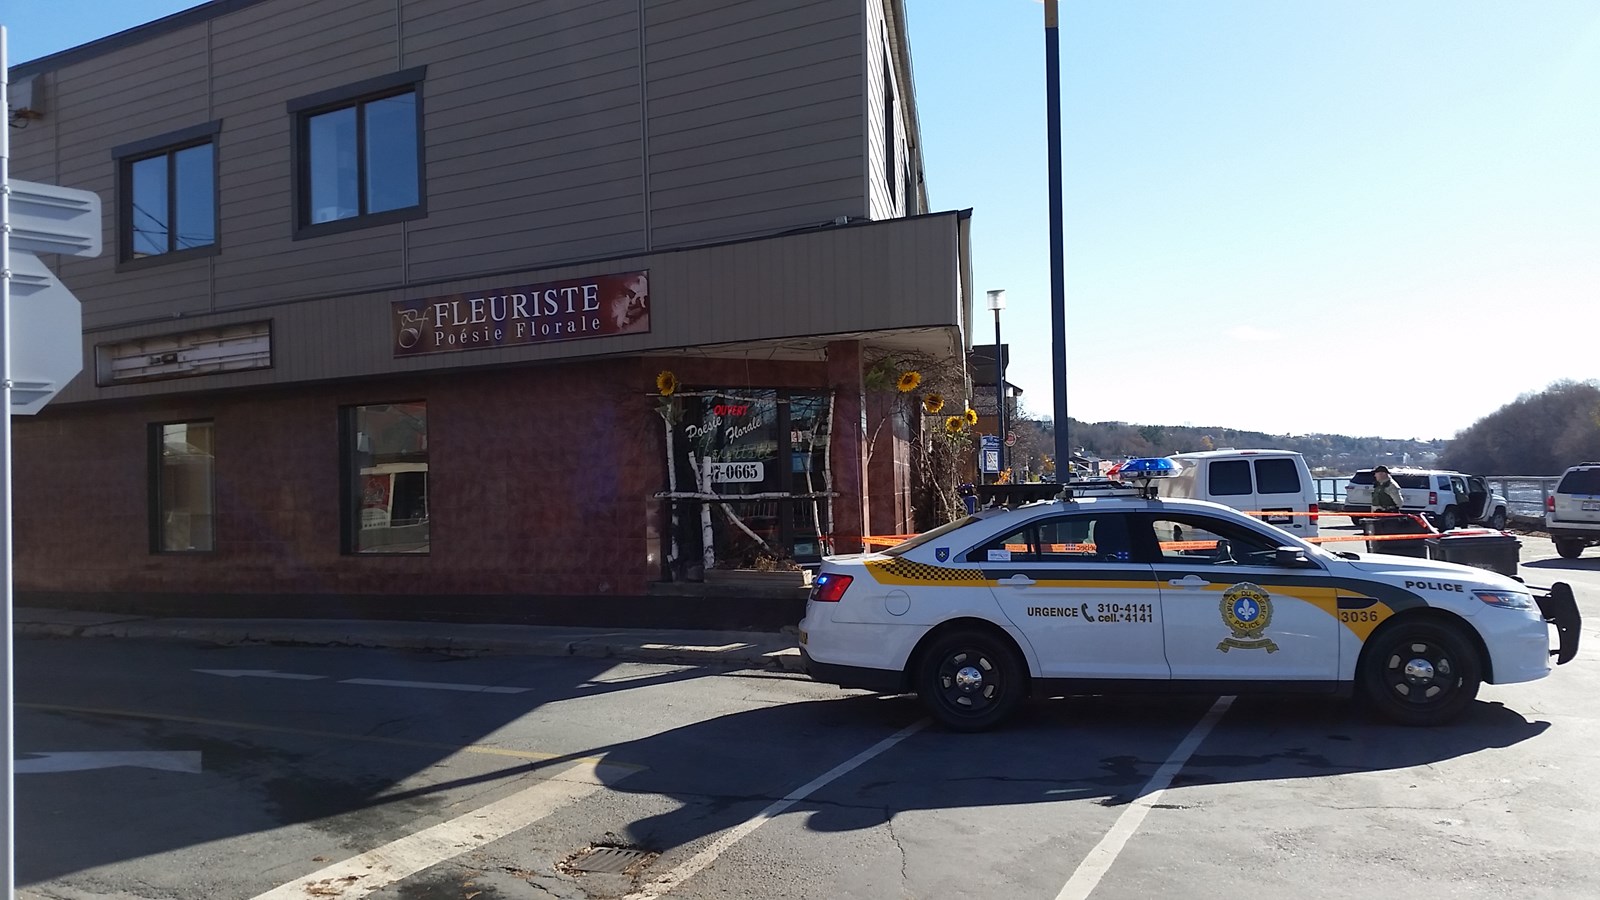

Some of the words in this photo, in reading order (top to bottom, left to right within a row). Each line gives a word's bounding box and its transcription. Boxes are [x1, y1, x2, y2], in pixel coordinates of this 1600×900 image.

[434, 284, 600, 328] FLEURISTE
[435, 326, 502, 346] Poésie
[516, 315, 600, 338] Florale
[713, 405, 748, 416] OUVERT
[725, 417, 761, 444] Florale
[706, 464, 758, 480] 7-0665
[1405, 580, 1463, 593] POLICE
[1027, 606, 1078, 617] URGENCE
[1097, 603, 1152, 613] 310-4141
[1341, 610, 1377, 623] 3036
[1234, 620, 1260, 629] POLICE
